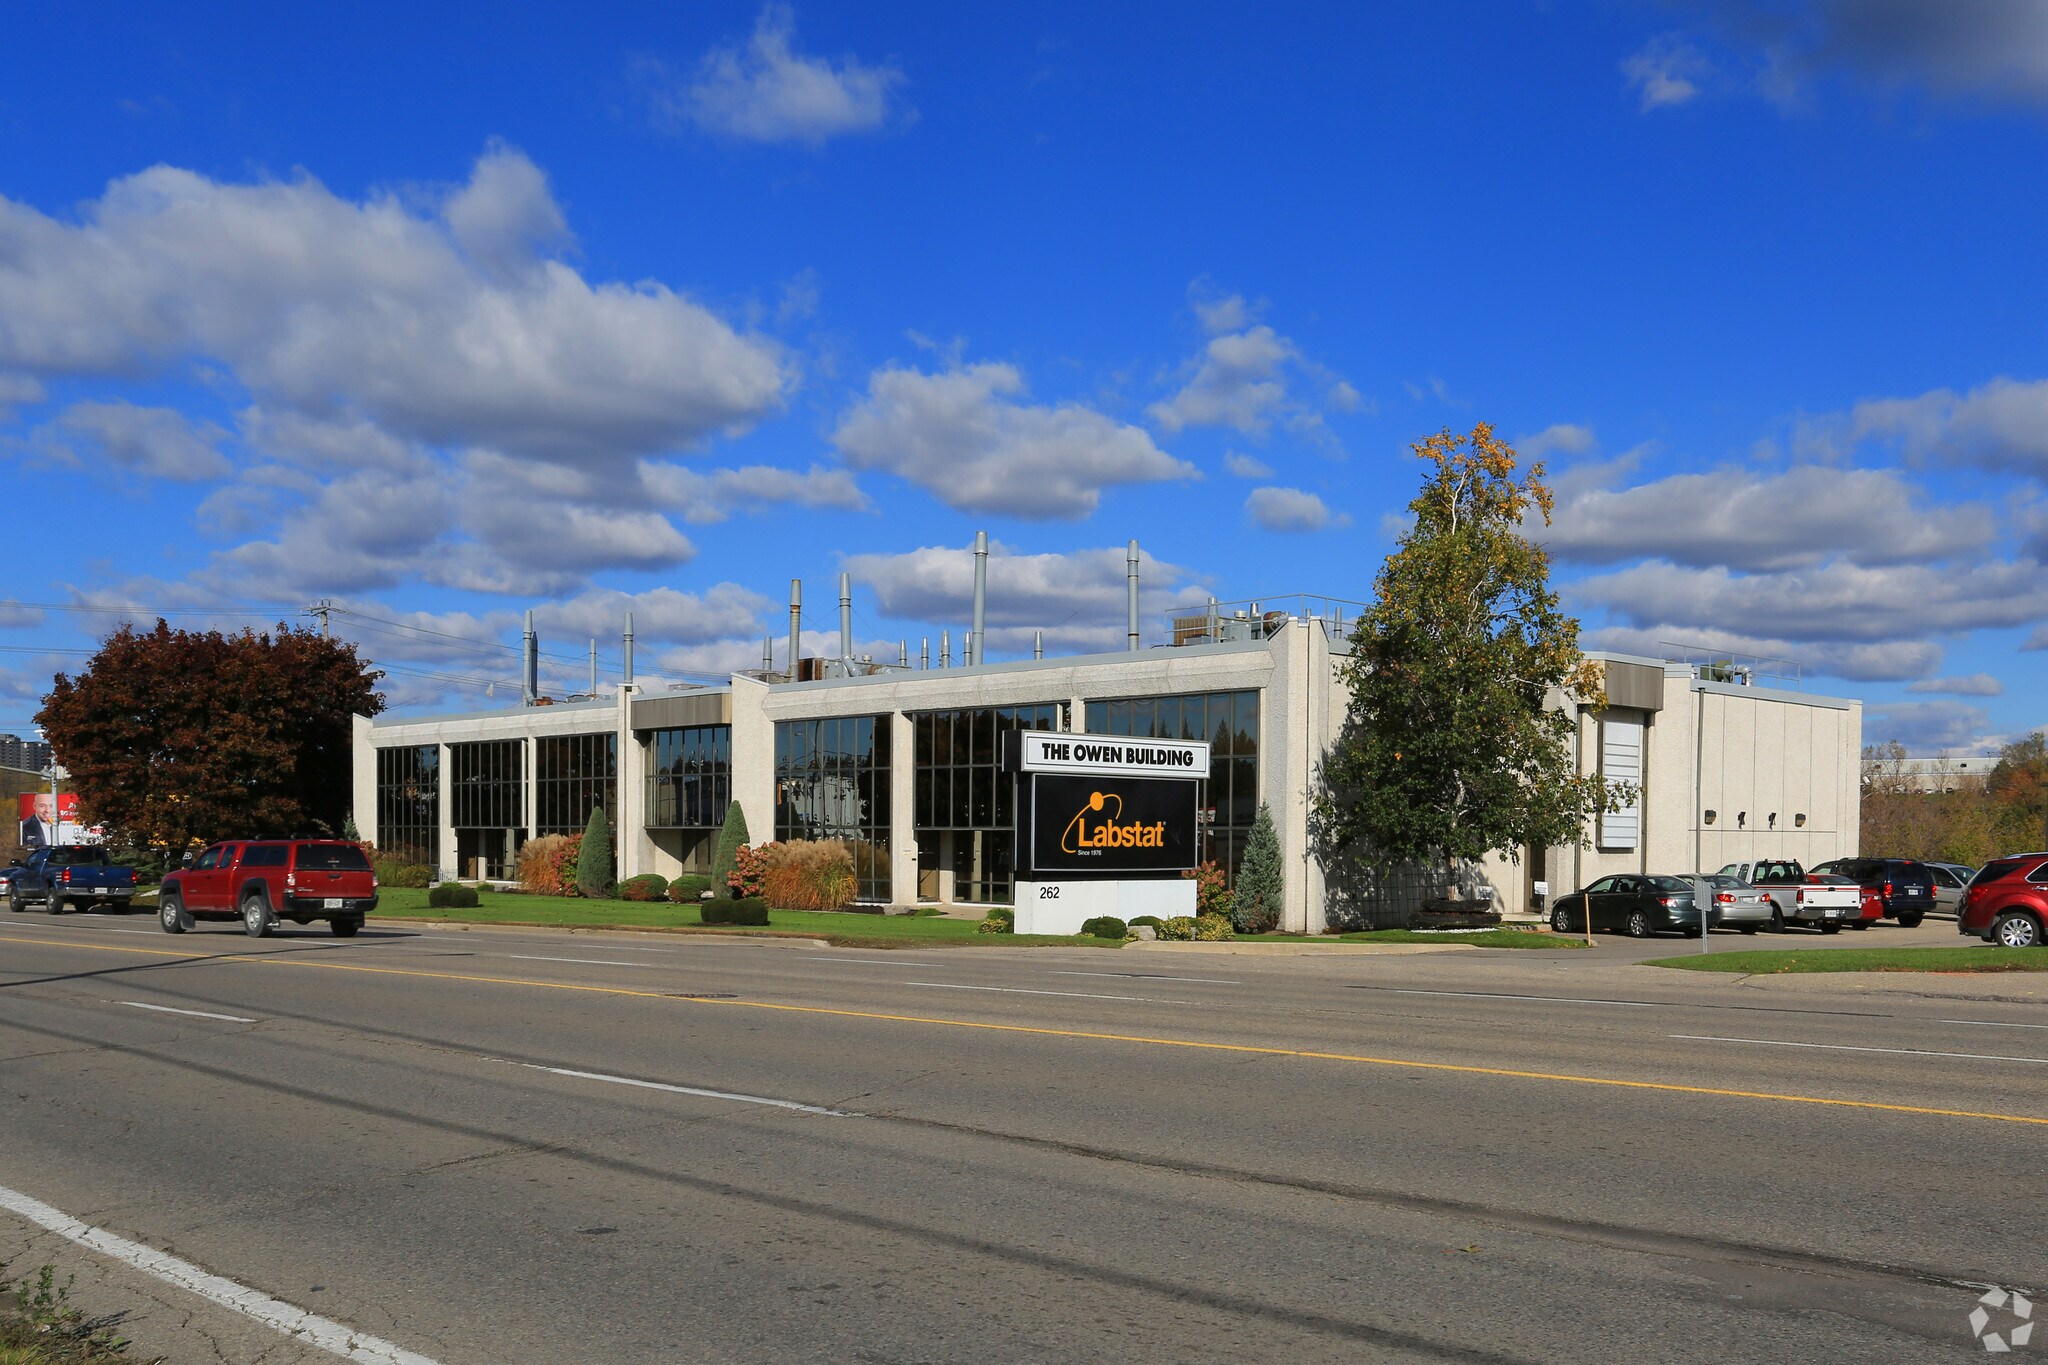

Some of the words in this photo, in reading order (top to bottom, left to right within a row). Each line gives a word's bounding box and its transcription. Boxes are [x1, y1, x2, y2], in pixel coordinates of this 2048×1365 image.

[1042, 743, 1069, 760] THE
[1073, 744, 1122, 763] OWEN
[1126, 747, 1193, 766] BUILDING
[1078, 818, 1164, 847] Labstat
[1040, 886, 1060, 899] 262
